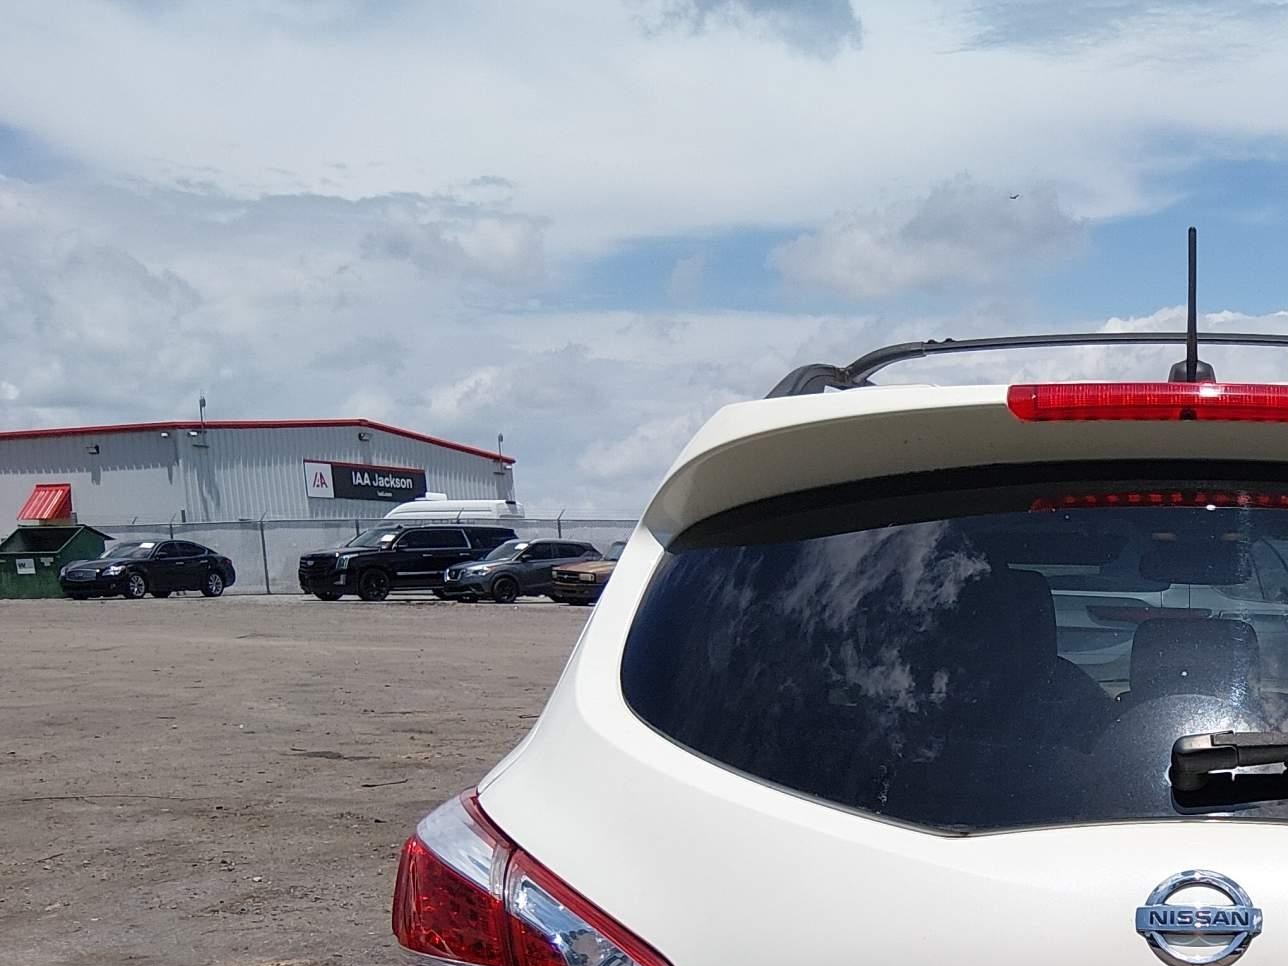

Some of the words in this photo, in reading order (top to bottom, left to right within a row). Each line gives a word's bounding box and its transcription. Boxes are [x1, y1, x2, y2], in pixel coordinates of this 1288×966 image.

[352, 471, 371, 486] IAA
[373, 473, 413, 489] Jackson
[1149, 910, 1249, 926] NISSAN
